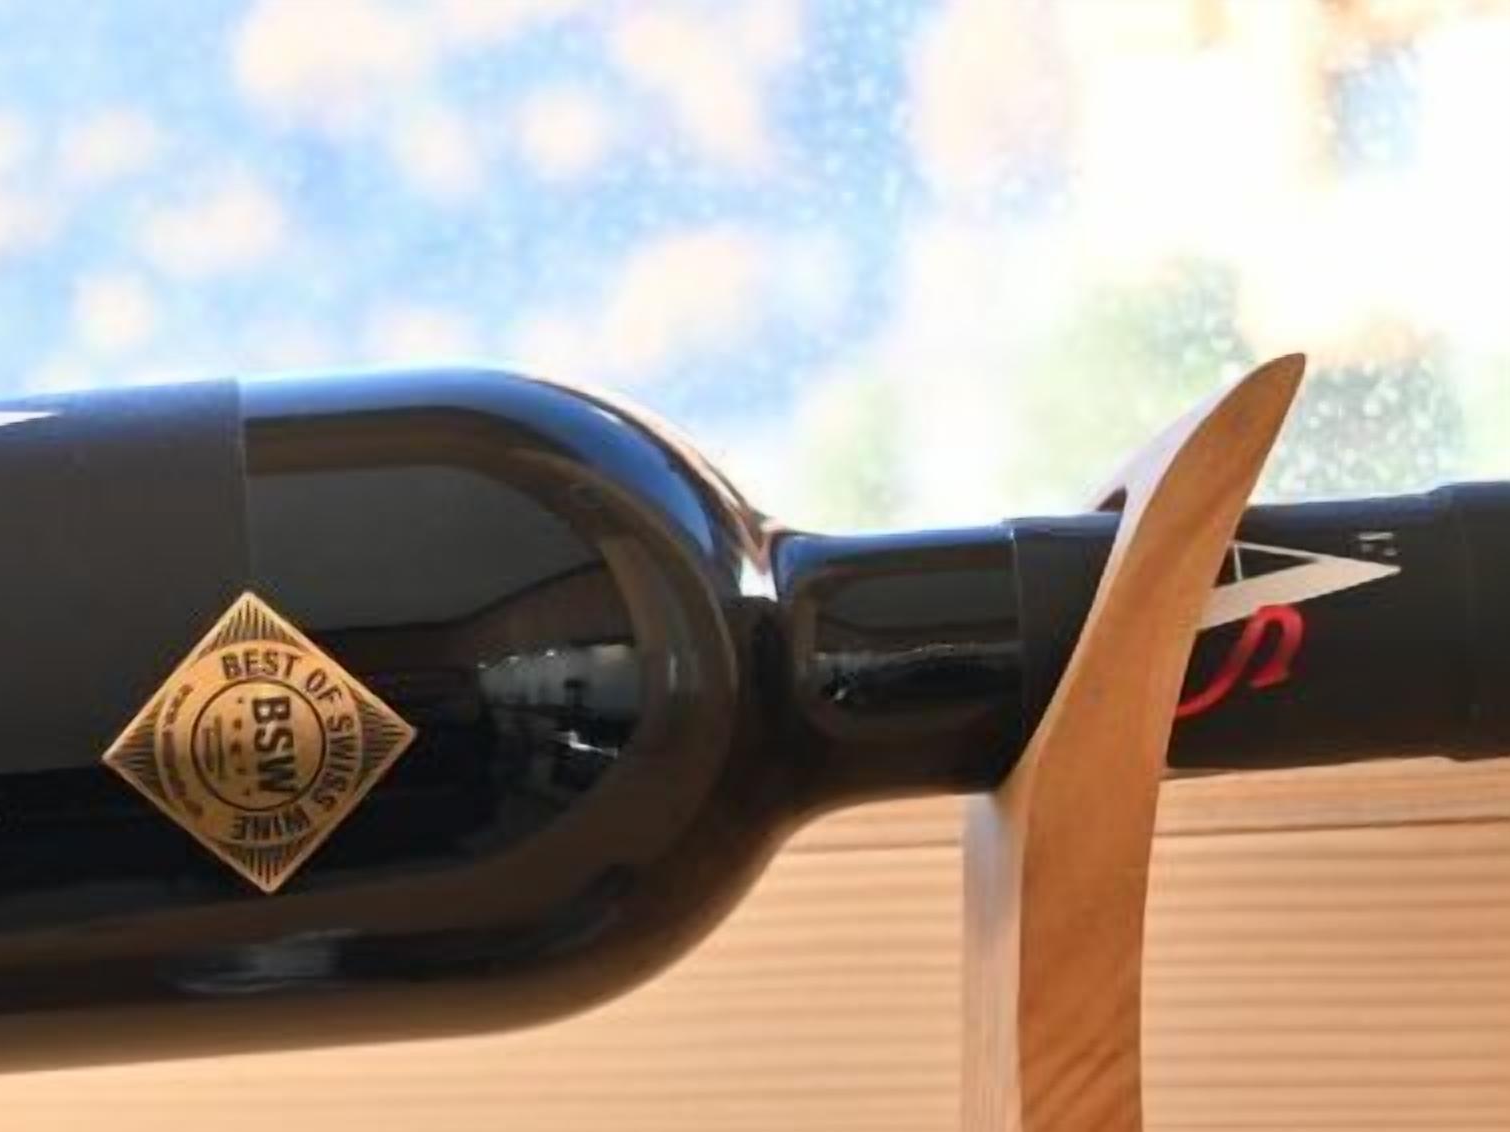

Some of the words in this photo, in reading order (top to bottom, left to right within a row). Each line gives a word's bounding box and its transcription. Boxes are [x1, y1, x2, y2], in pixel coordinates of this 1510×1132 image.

[221, 649, 301, 681] BEST
[305, 666, 343, 704] OF
[251, 695, 298, 794] BSW
[309, 716, 357, 812] SWISS
[233, 805, 311, 842] WINE
